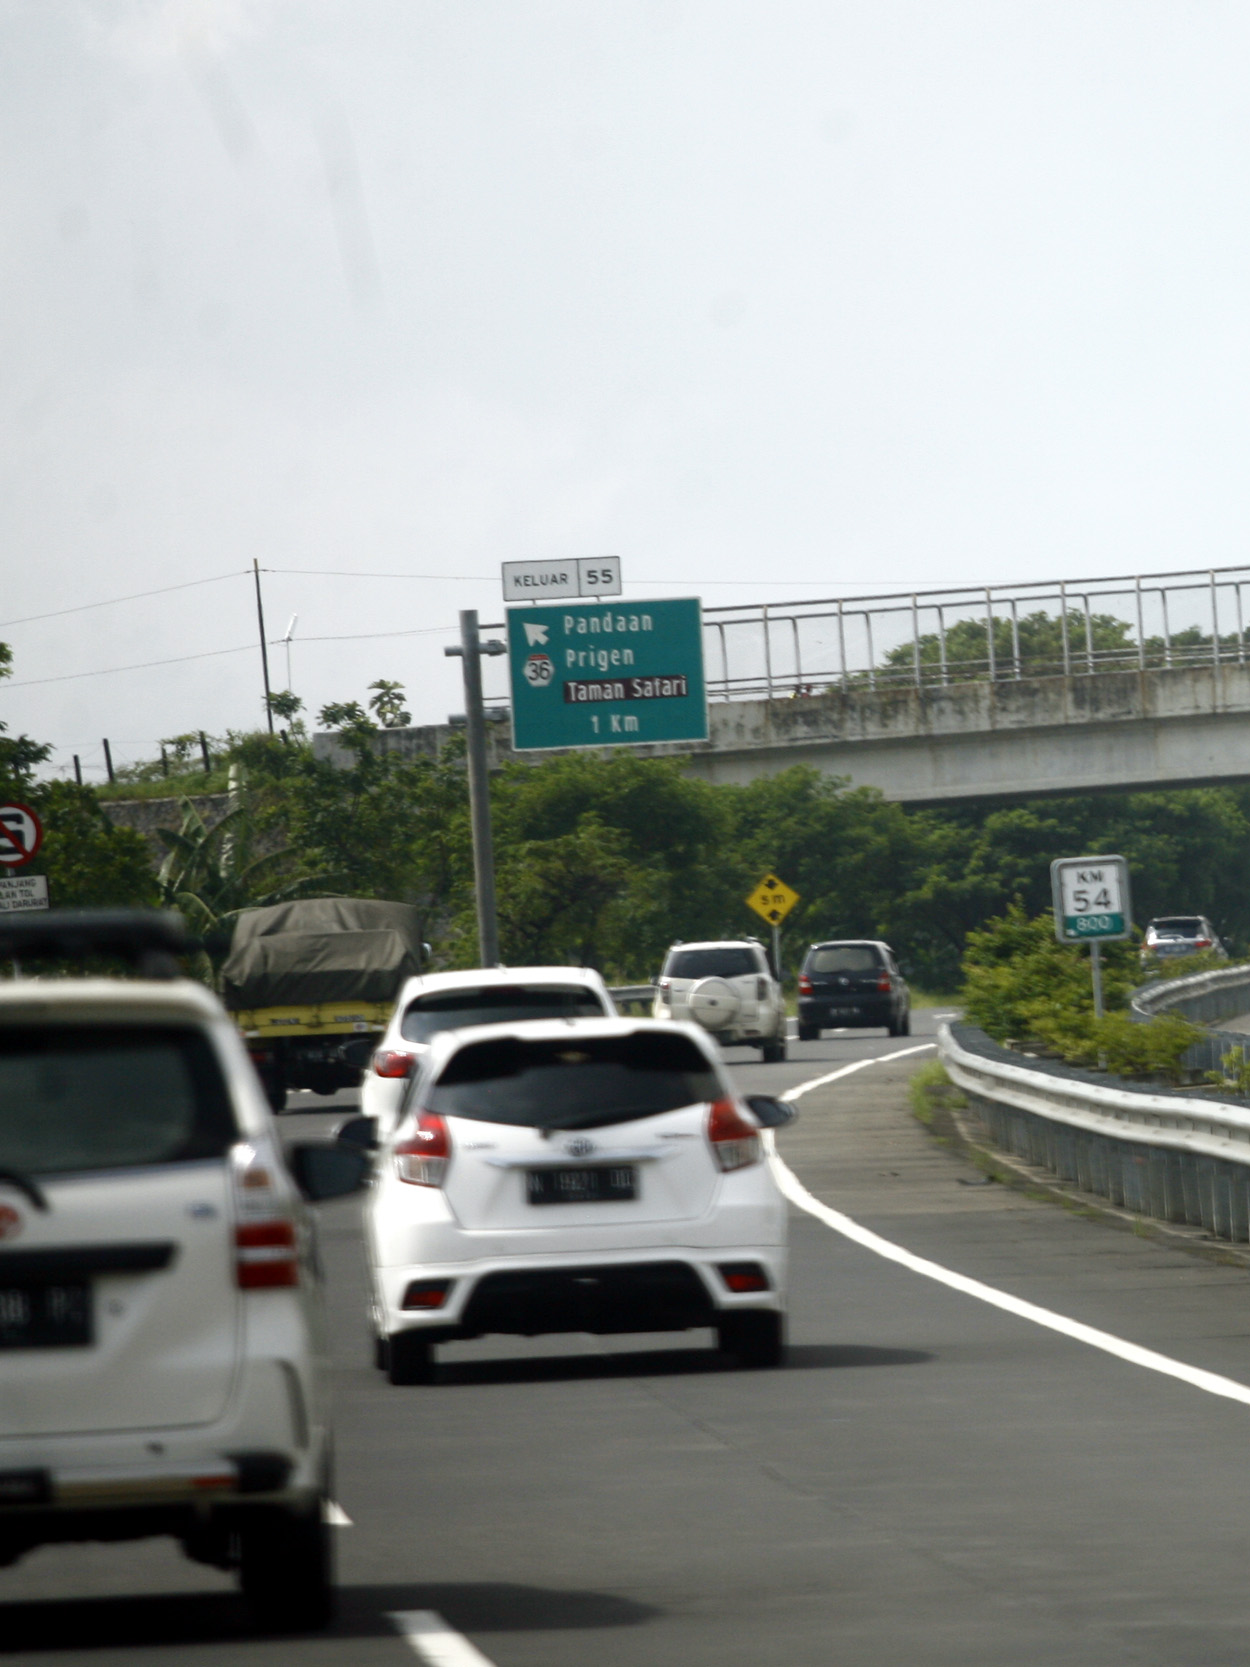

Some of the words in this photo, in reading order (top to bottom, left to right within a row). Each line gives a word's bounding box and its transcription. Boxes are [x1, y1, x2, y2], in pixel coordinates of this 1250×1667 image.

[513, 573, 568, 588] KELUAR
[586, 568, 613, 585] 55
[563, 612, 653, 636] Pandaan
[565, 645, 635, 672] Prigen
[527, 661, 550, 681] 36
[567, 681, 625, 702] Taman
[632, 676, 688, 698] Safari
[591, 714, 600, 734] 1
[611, 714, 640, 733] Km
[1076, 870, 1104, 884] KM
[759, 894, 769, 906] 5
[1072, 888, 1111, 912] 54
[1076, 916, 1110, 931] 800
